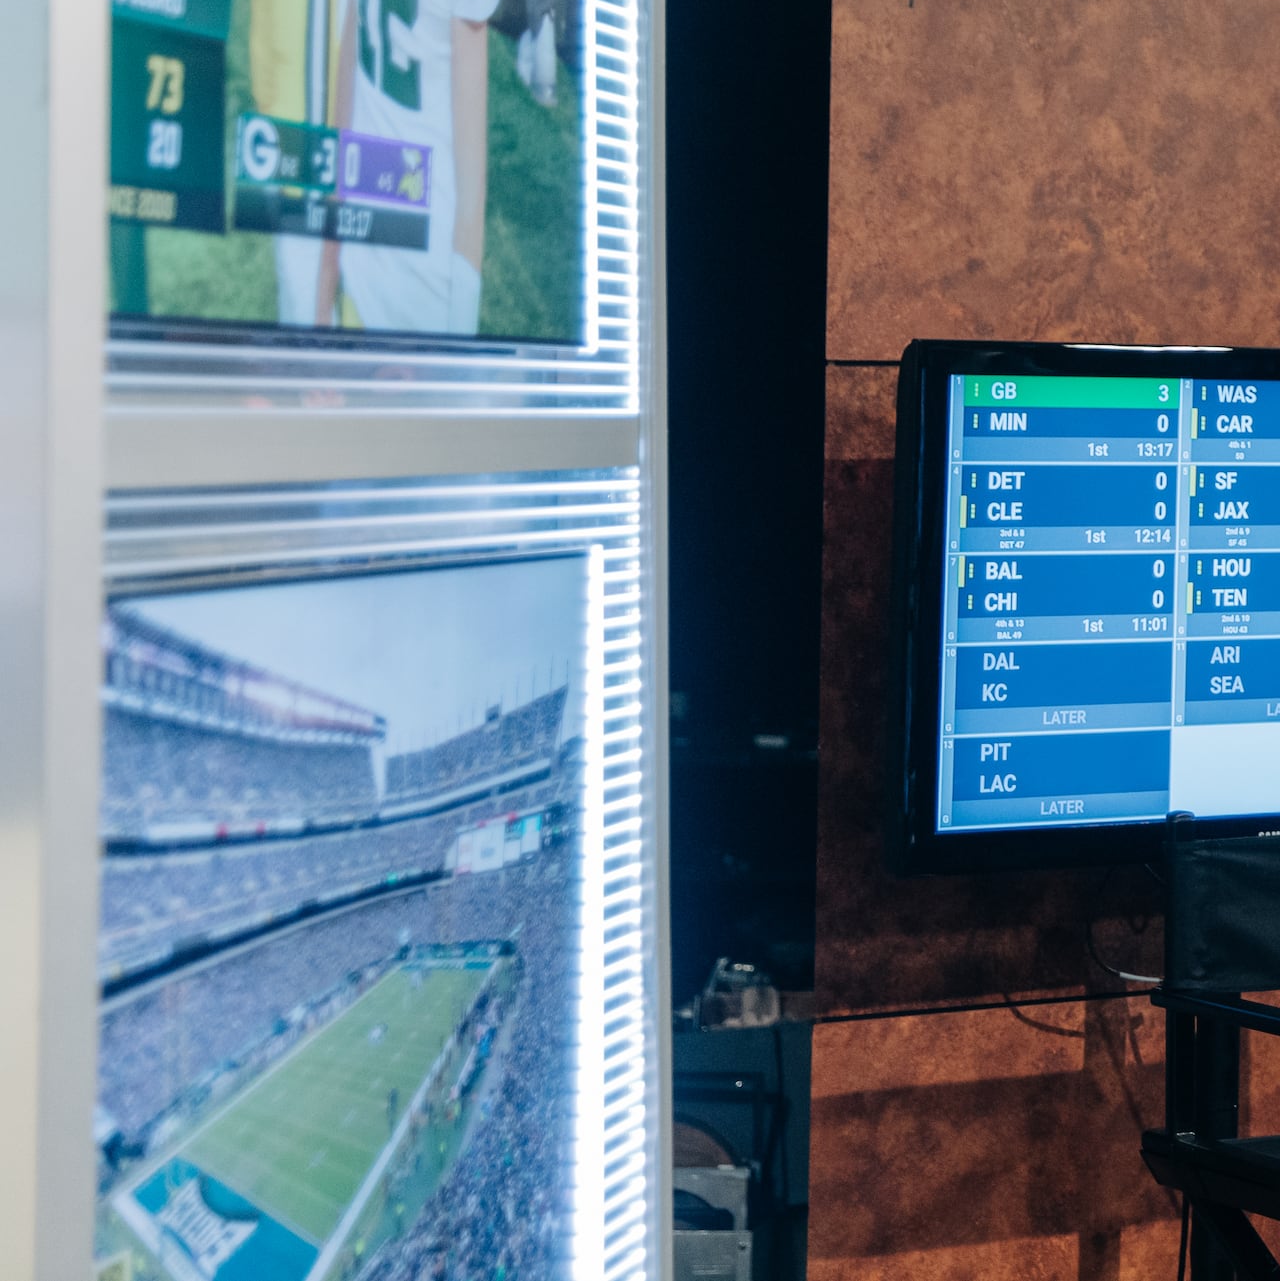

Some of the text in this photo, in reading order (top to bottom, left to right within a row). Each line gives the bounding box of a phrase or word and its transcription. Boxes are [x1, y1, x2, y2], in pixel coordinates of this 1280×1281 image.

[146, 54, 185, 114] 73
[147, 120, 182, 169] 20
[344, 143, 361, 188] 0
[991, 382, 1169, 401] GB 3
[1217, 385, 1257, 403] WAS
[990, 413, 1169, 432] MIN 0
[1216, 415, 1253, 433] CAR
[1088, 443, 1173, 456] 1st 13:17
[988, 472, 1167, 490] DET 0
[1215, 472, 1237, 489] SF
[987, 502, 1166, 520] CLE 0
[1214, 502, 1249, 519] JAX
[1085, 529, 1171, 543] 1st 12:14
[985, 560, 1165, 580] BAL 0
[1213, 558, 1251, 576] HOU
[984, 590, 1164, 611] CHI 0
[1212, 589, 1247, 606] TEN
[1083, 617, 1167, 632] 1st 11:01
[983, 652, 1019, 671] DAL
[1210, 646, 1240, 664] ARI
[982, 684, 1007, 702] KC
[1210, 676, 1244, 694] SEA
[1043, 711, 1086, 725] LATER
[980, 743, 1011, 761] PIT
[980, 774, 1016, 793] LAC
[1041, 800, 1084, 815] LATER
